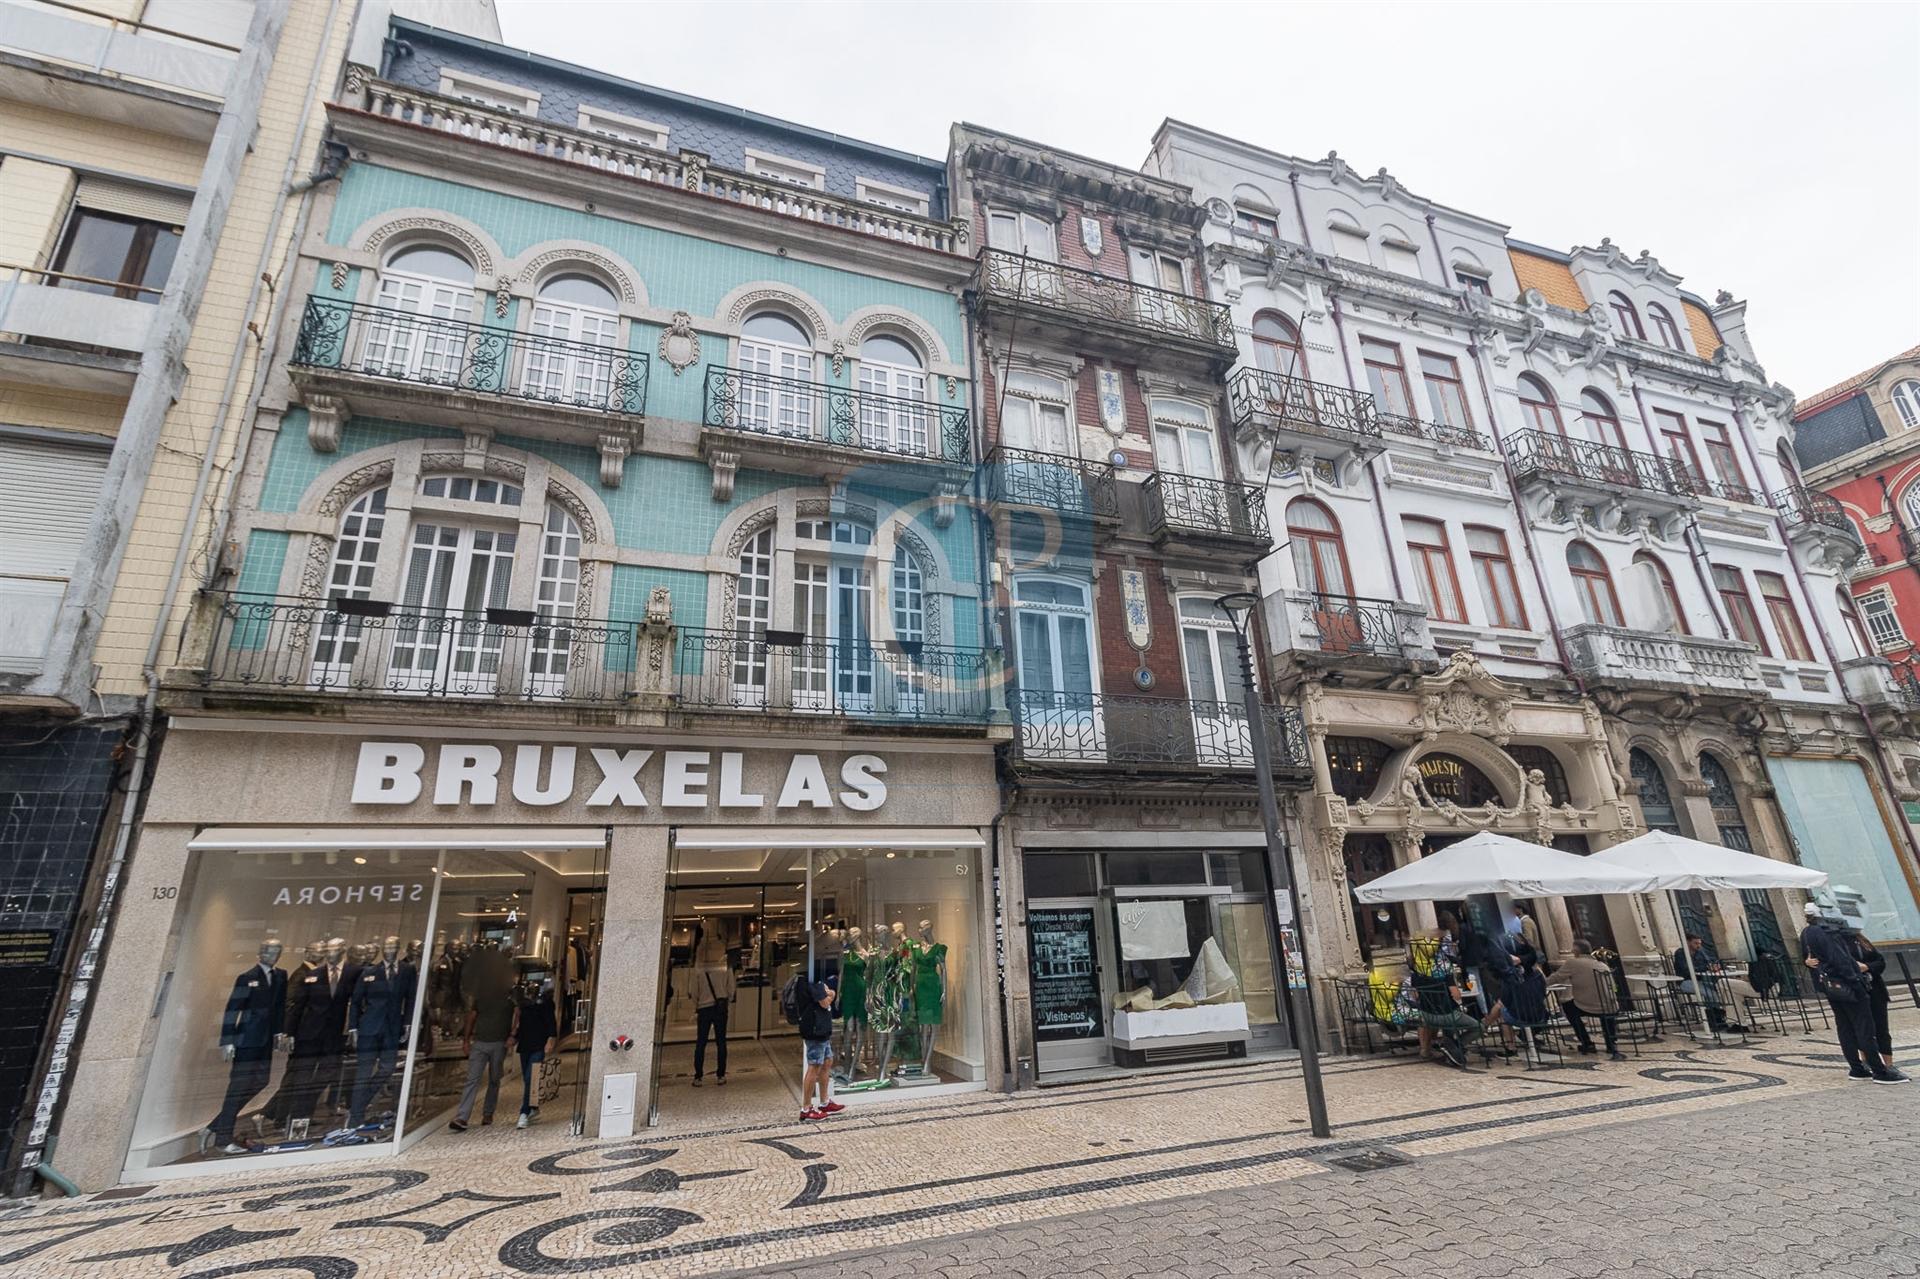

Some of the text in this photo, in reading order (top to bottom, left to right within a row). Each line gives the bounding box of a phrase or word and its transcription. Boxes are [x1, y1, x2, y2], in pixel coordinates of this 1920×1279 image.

[351, 742, 888, 812] BRUXELAS
[1418, 760, 1465, 779] MAJESTIC
[152, 886, 178, 900] 130
[1045, 1009, 1086, 1022] Visite-nos
